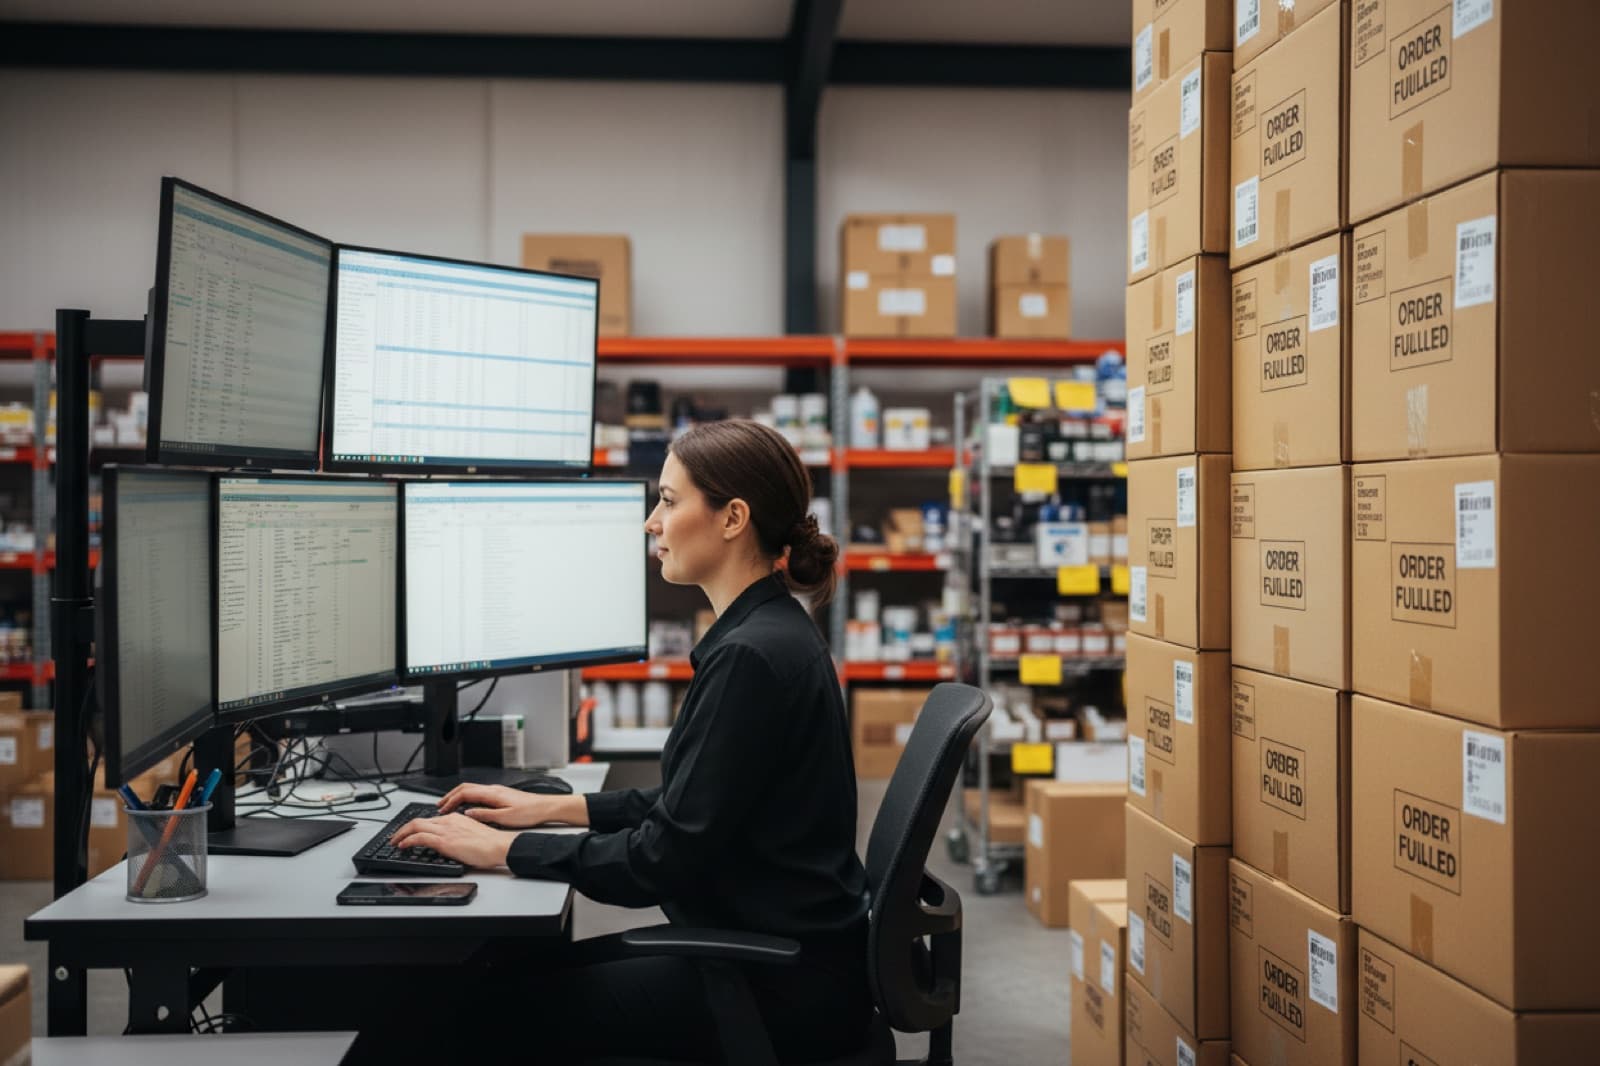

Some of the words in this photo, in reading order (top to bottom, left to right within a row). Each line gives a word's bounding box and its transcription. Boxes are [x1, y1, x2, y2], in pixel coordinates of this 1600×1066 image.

[1399, 24, 1442, 70] ORDER
[1398, 292, 1443, 326] ORDER
[1399, 553, 1446, 580] ORDER
[1402, 804, 1450, 844] ORDER
